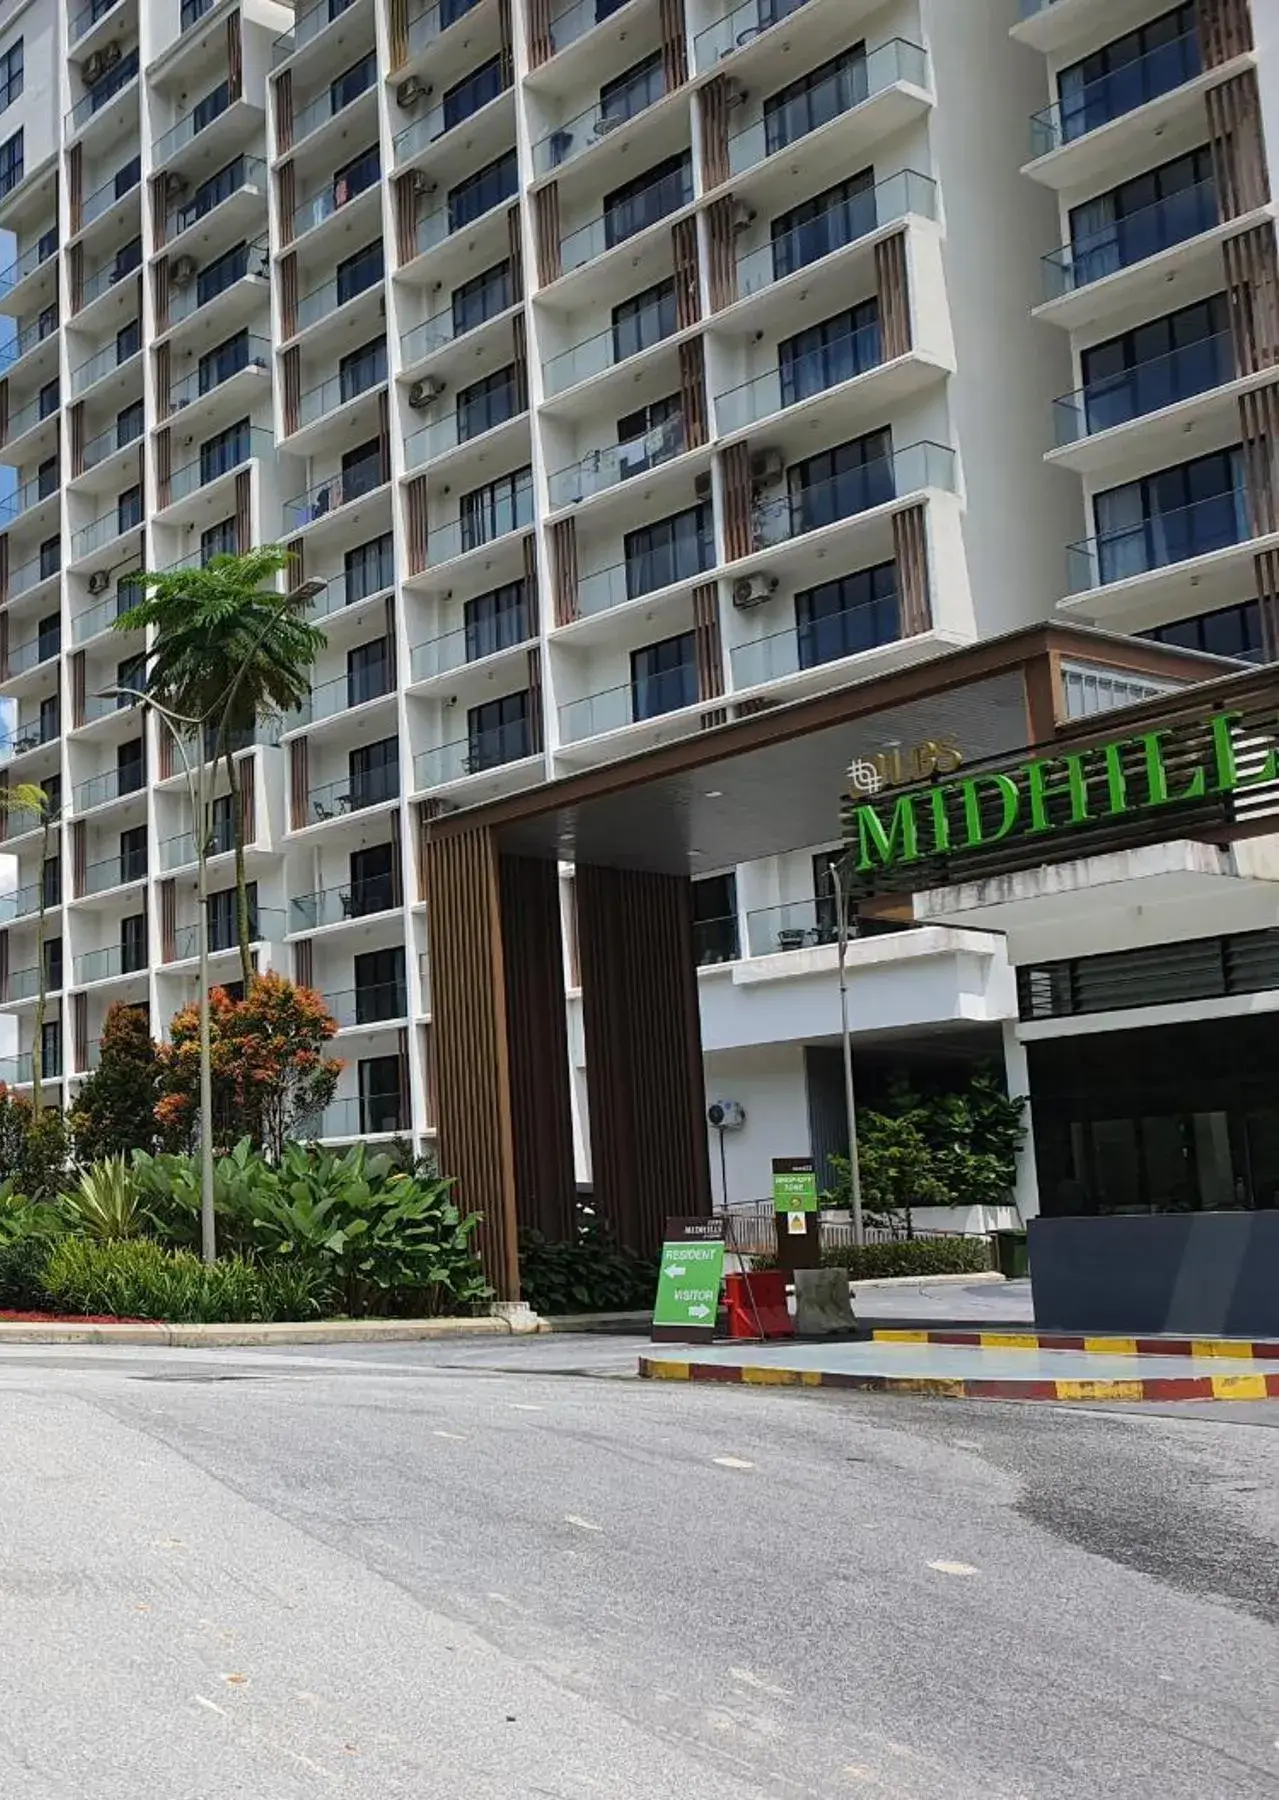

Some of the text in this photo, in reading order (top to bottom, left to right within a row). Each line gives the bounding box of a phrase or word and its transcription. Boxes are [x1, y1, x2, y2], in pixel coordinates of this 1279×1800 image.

[854, 711, 1279, 872] MIDHILL
[666, 1248, 716, 1260] RESIDENT
[674, 1289, 714, 1301] VISITOR
